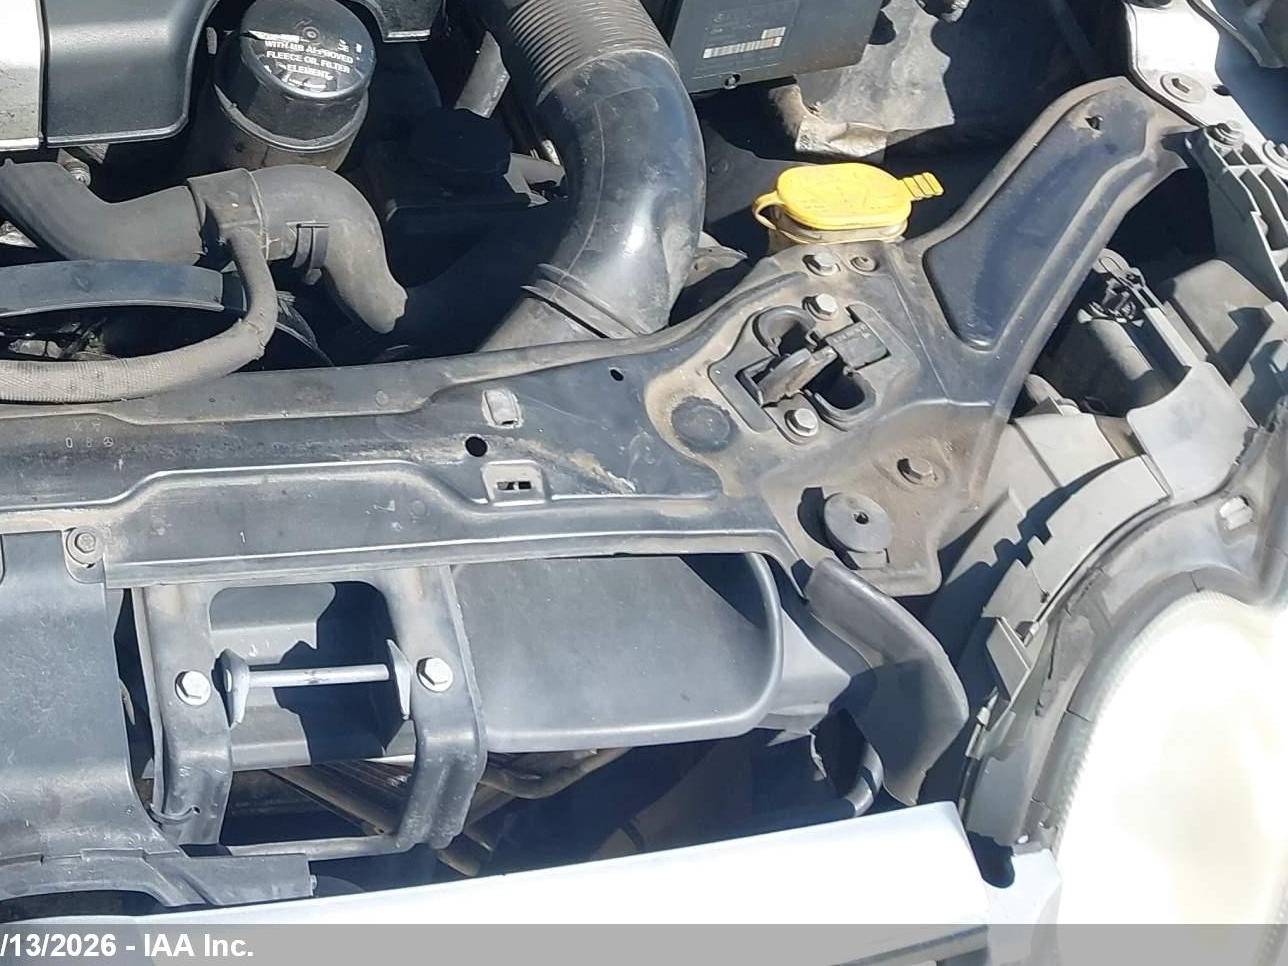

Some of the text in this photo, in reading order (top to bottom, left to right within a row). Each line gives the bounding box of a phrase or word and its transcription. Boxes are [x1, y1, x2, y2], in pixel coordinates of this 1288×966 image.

[266, 50, 351, 74] FLEECE OIL FILTER
